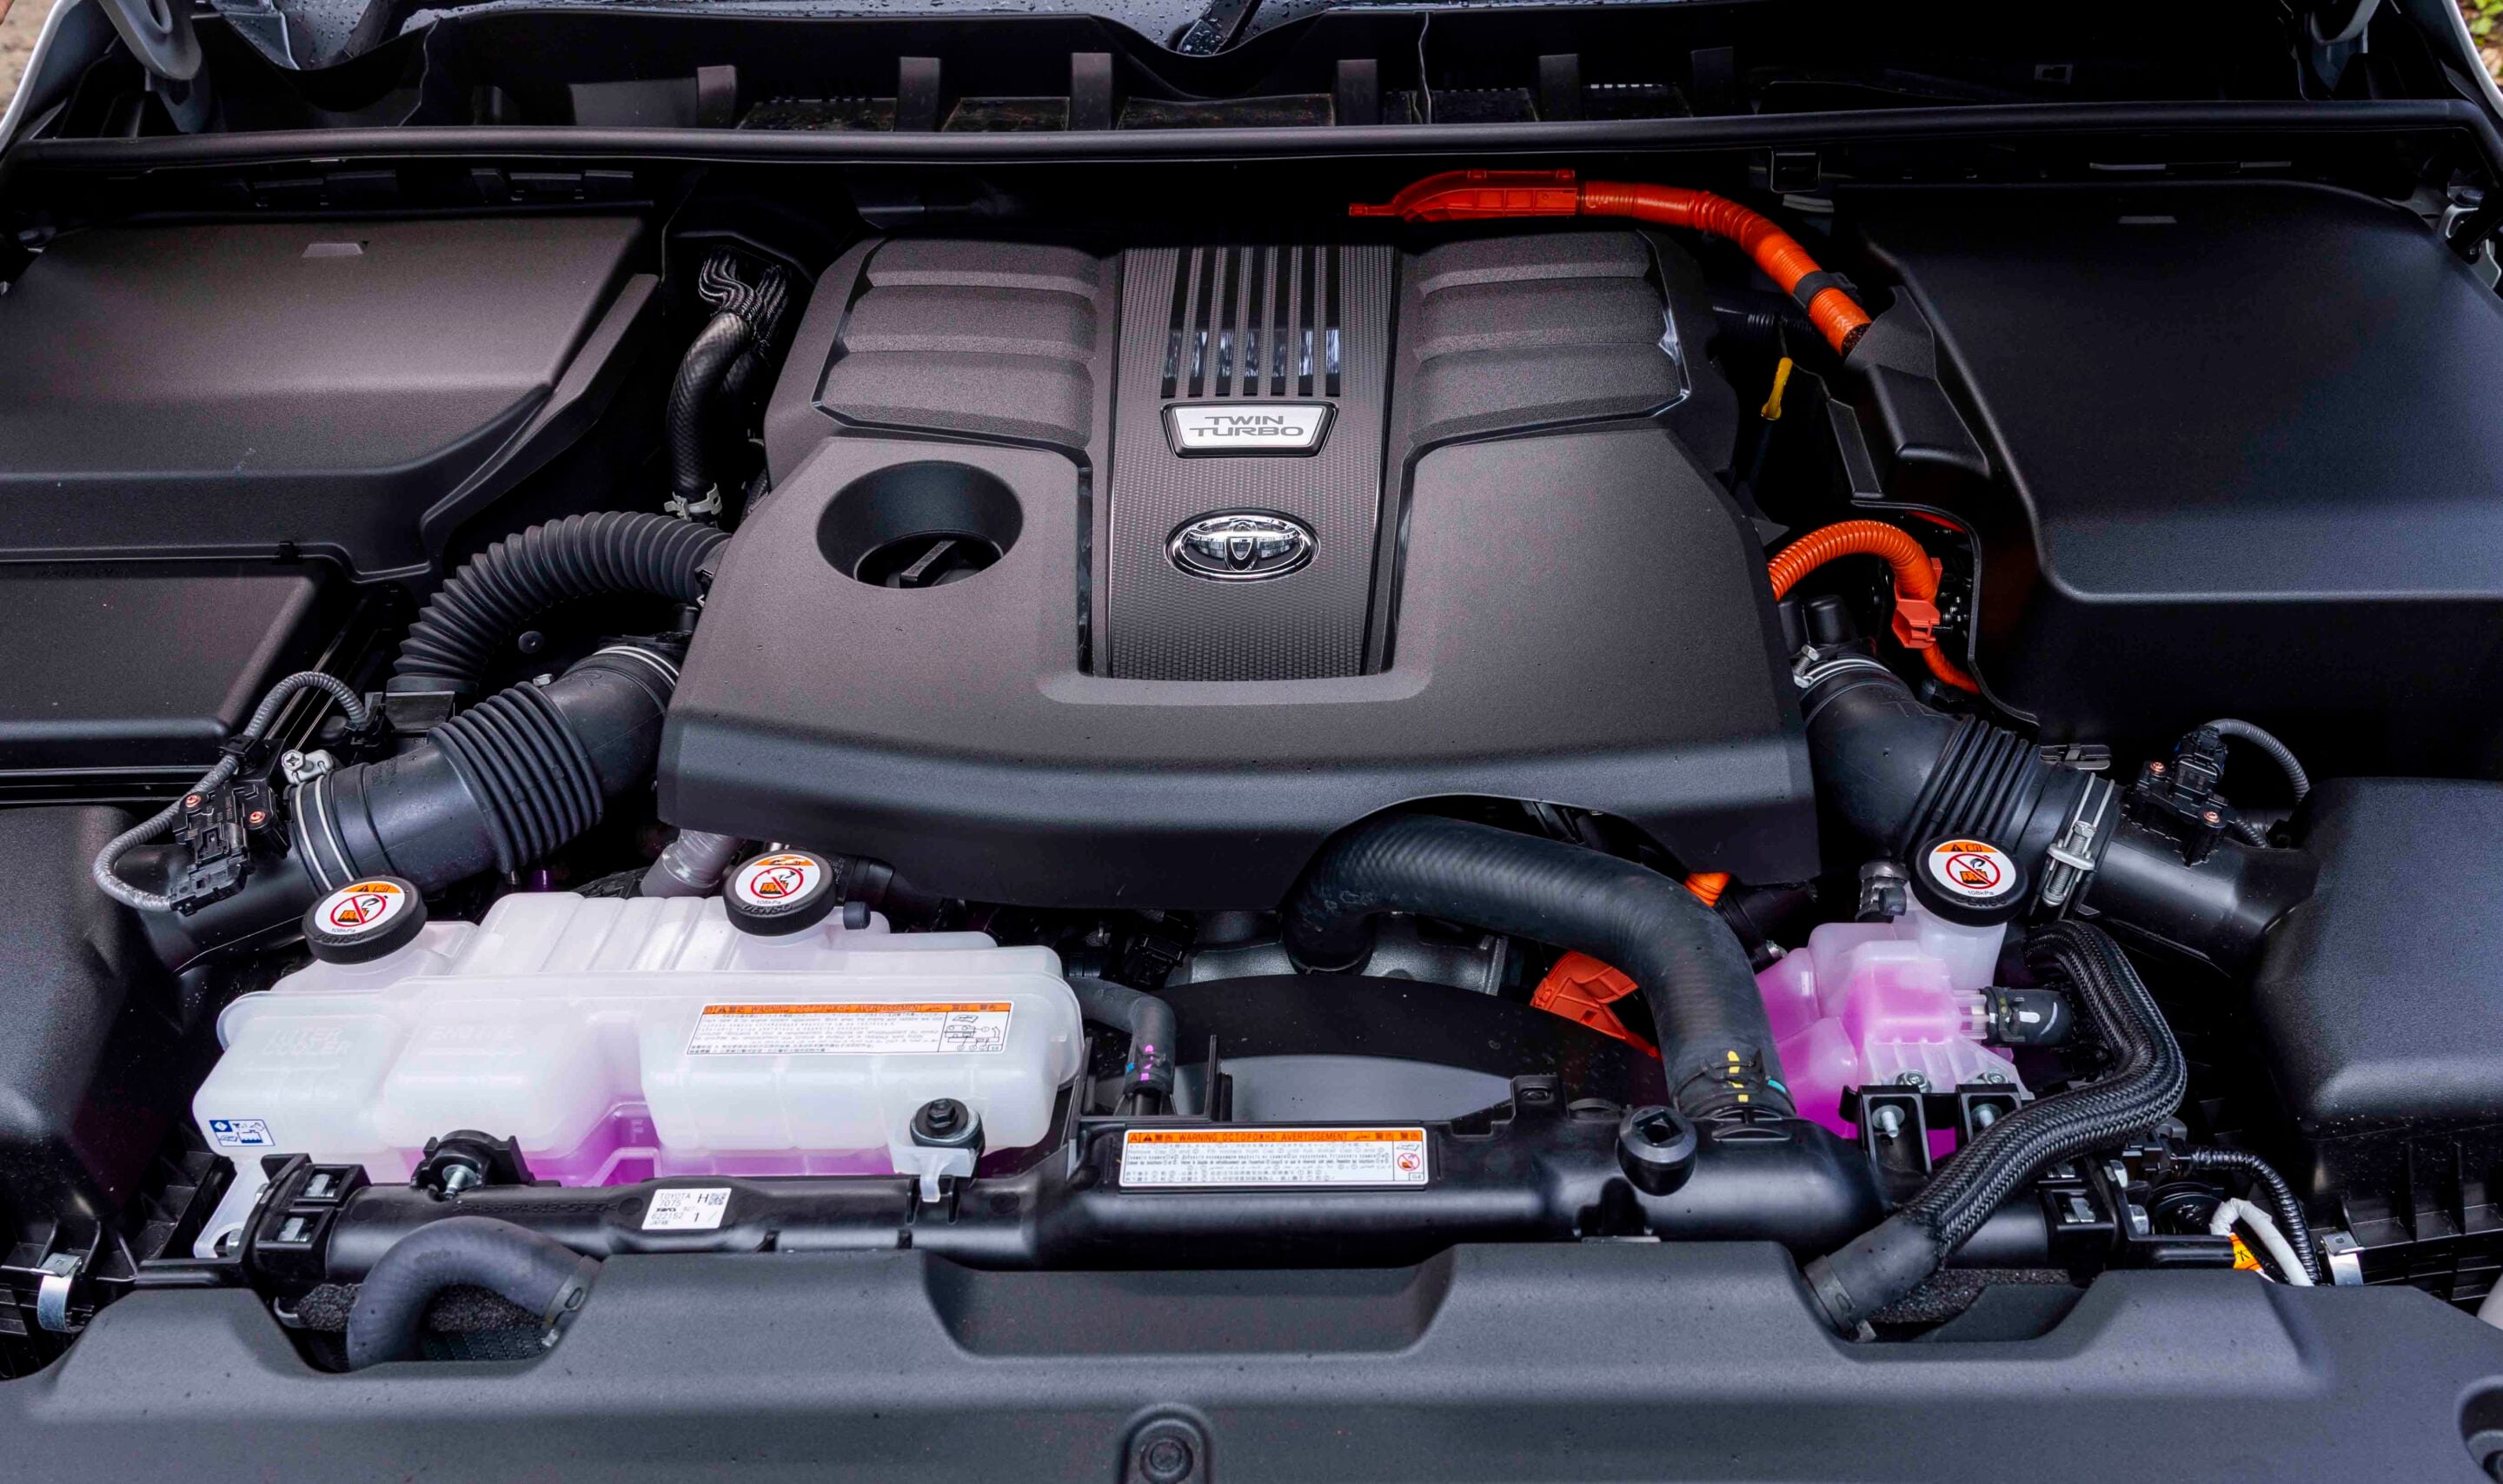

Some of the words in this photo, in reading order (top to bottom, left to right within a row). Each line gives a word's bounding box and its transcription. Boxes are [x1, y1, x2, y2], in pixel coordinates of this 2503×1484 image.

[1205, 415, 1284, 425] TWIN
[1189, 427, 1304, 437] TURBO
[741, 903, 793, 915] DENSO
[314, 932, 368, 944] DENSO
[856, 1004, 923, 1012] AVERTISSEMENT
[630, 1119, 644, 1143] F
[1281, 1132, 1348, 1141] AVERTISSEMENT
[697, 1193, 710, 1203] H
